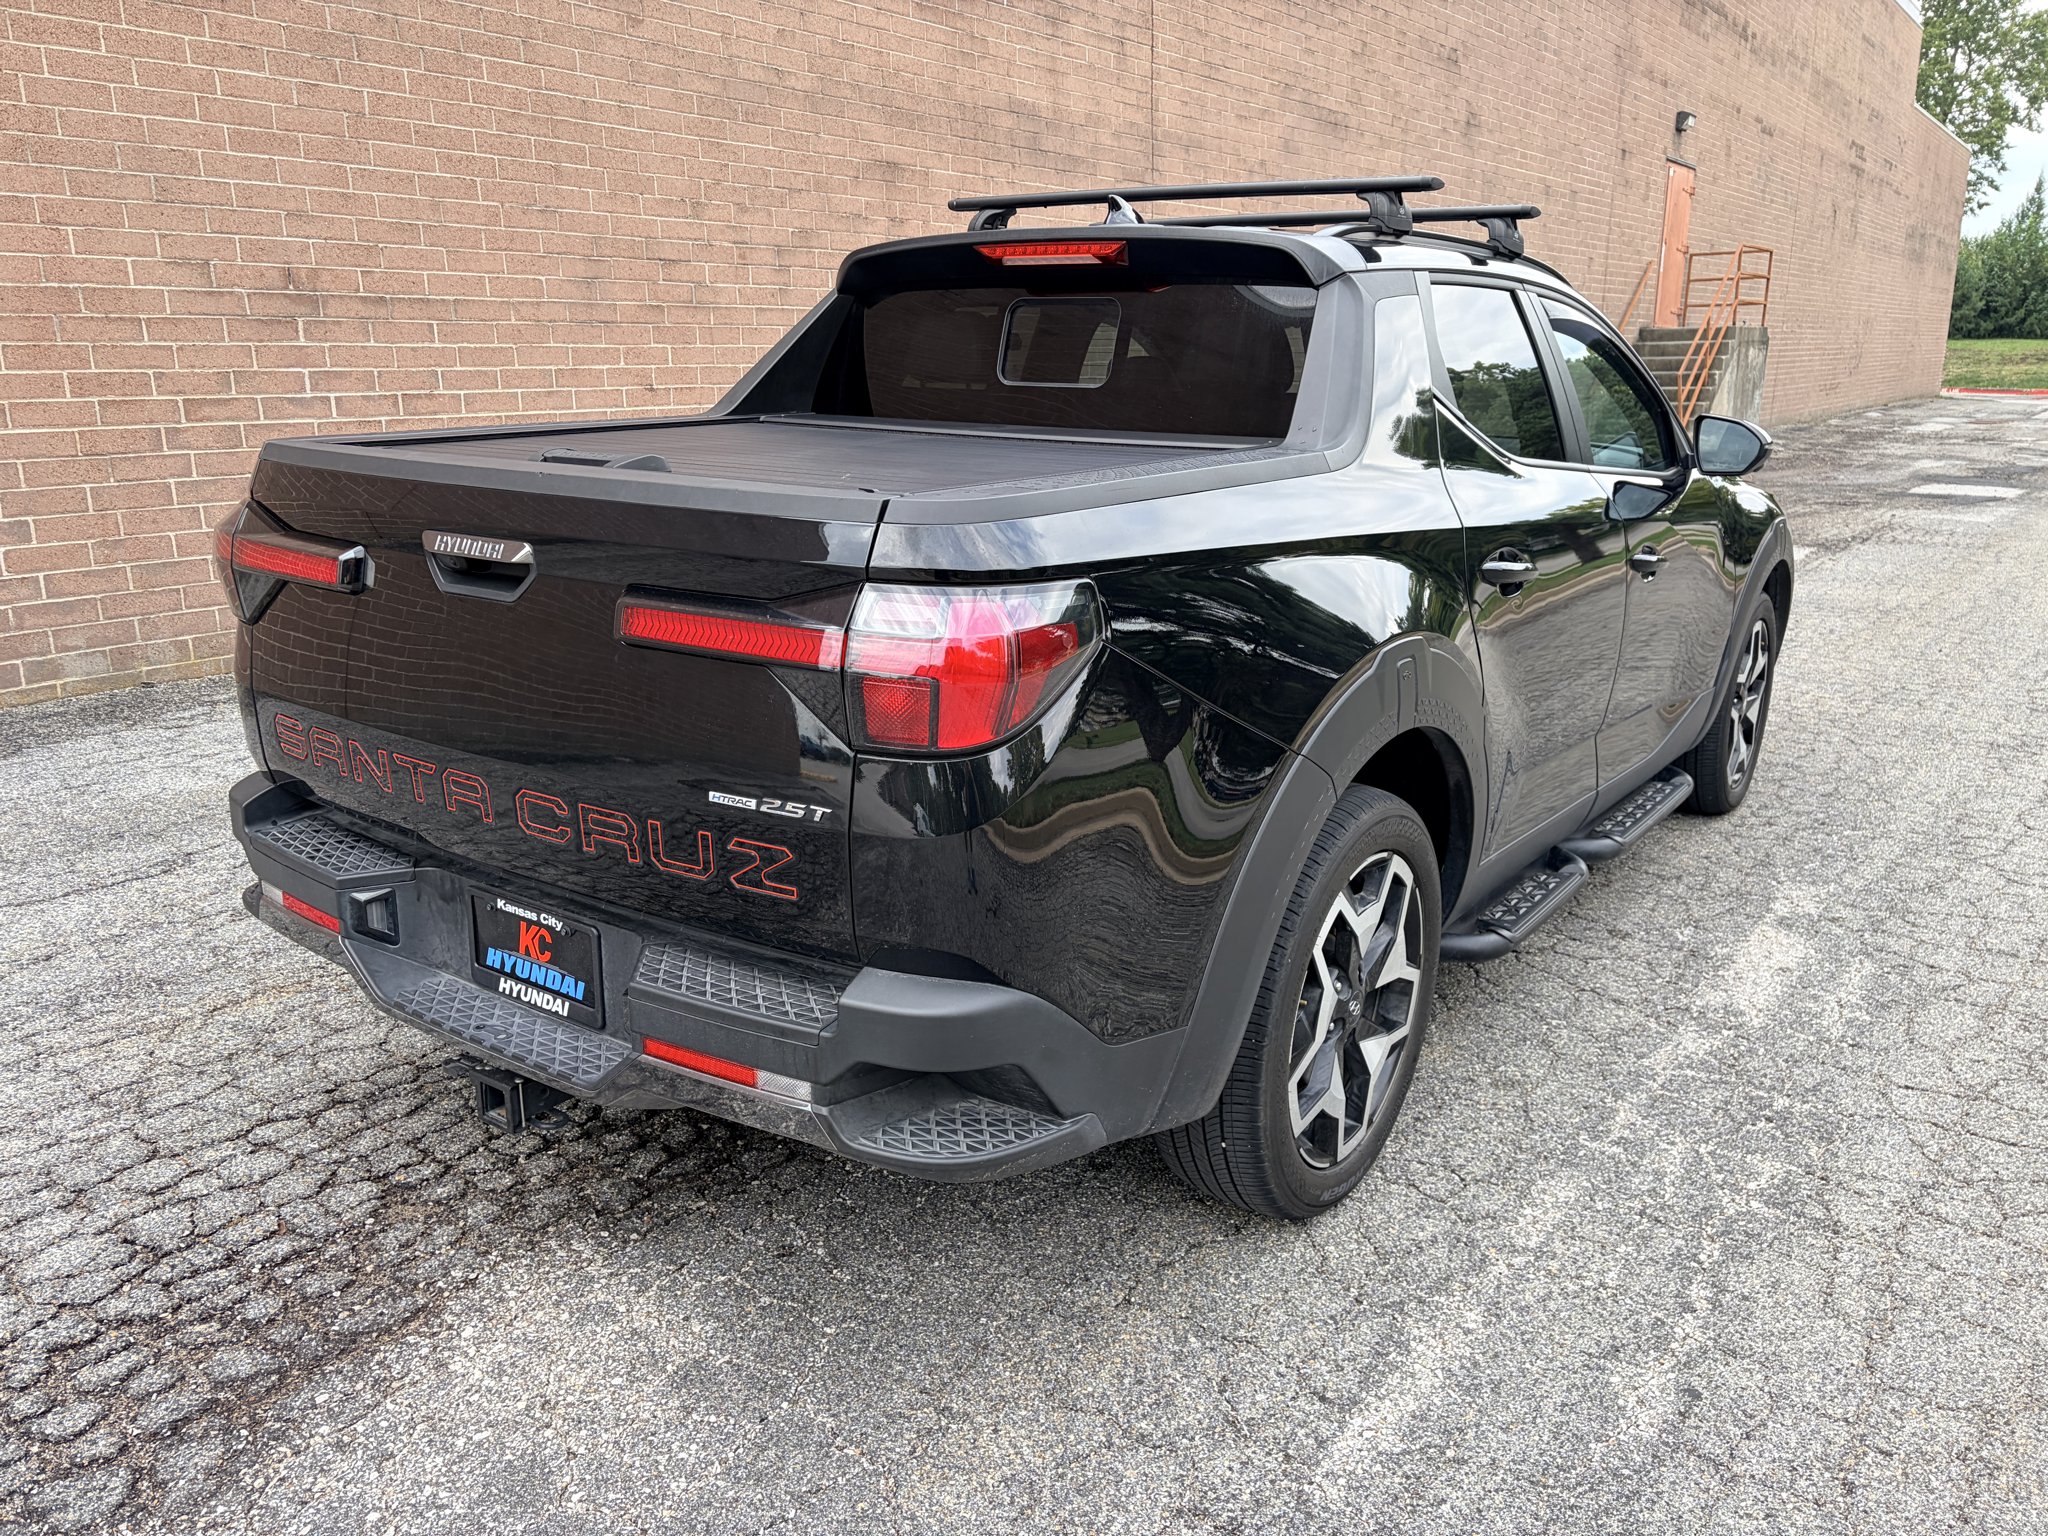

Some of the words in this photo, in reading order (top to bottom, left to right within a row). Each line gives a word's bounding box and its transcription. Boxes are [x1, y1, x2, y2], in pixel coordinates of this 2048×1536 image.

[434, 535, 504, 559] HYUNDAI
[275, 713, 493, 823] SANTA
[515, 789, 798, 899] CRUZ
[712, 794, 752, 808] HTRAC
[497, 898, 537, 921] Kansas
[540, 913, 563, 932] City
[518, 921, 552, 963] KC
[486, 947, 585, 1001] HYUNDAI
[499, 978, 569, 1017] HYUNDAI
